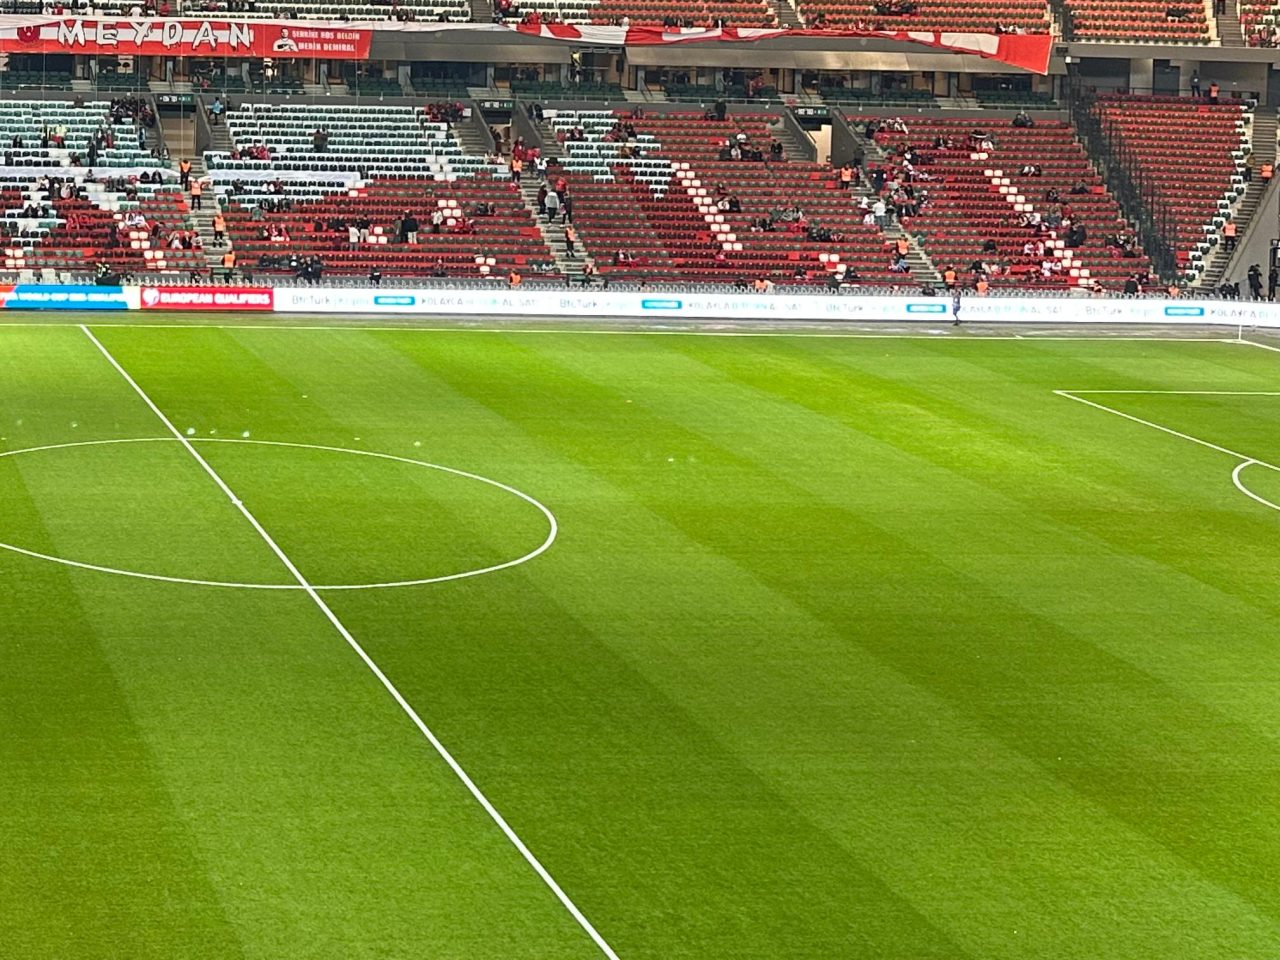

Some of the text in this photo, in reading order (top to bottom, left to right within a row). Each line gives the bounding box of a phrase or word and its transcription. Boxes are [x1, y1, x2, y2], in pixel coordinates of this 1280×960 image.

[57, 19, 251, 50] MEYDAN
[160, 293, 270, 304] EUROPEAN QUALIFIERS
